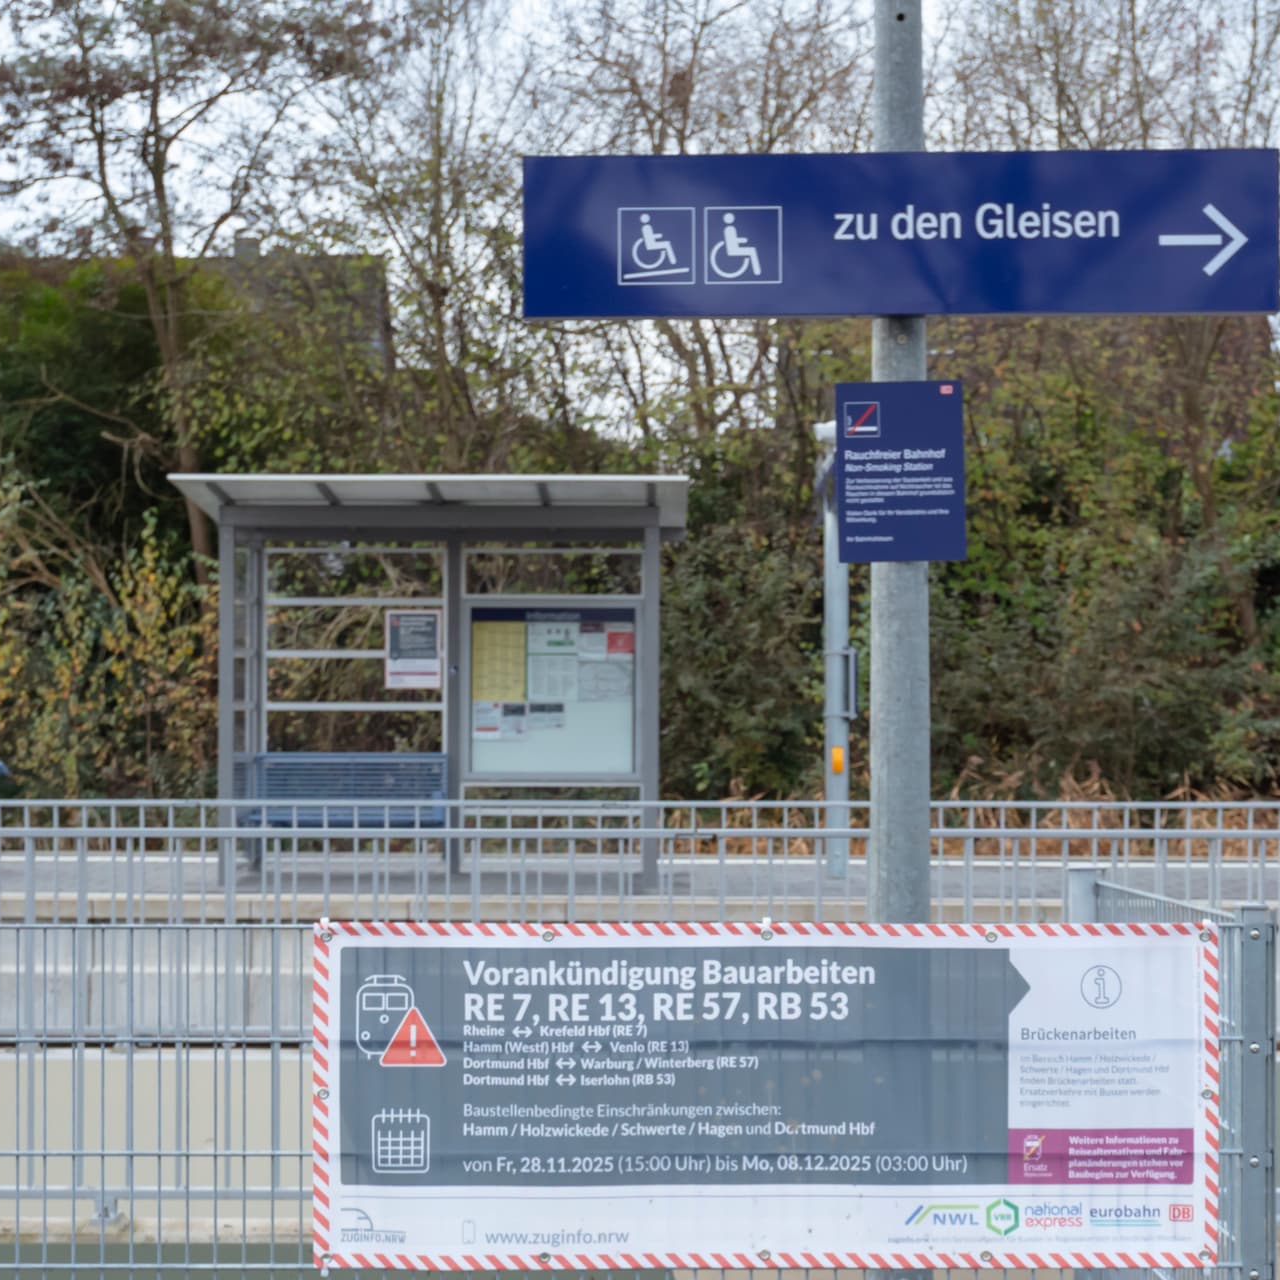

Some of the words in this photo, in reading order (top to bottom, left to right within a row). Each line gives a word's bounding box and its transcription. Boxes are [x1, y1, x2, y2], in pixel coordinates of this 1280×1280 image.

[833, 211, 878, 241] zu
[890, 204, 962, 240] den
[974, 202, 1121, 240] Gleisen
[844, 449, 902, 460] Rauchfreier
[903, 448, 946, 459] Bahnhof
[903, 462, 934, 472] Station
[463, 959, 697, 991] Vorankündigung
[702, 958, 876, 986] Bauarbeiten
[464, 993, 505, 1022] RE
[512, 993, 541, 1026] 7,
[548, 993, 590, 1022] RE
[599, 992, 646, 1026] 13,
[653, 993, 695, 1021] RE
[701, 992, 750, 1024] 57,
[757, 992, 802, 1021] RB
[809, 991, 850, 1021] 53
[463, 1025, 505, 1037] Rheine
[540, 1024, 586, 1037] Krefeld
[588, 1024, 611, 1037] Hbf
[612, 1025, 633, 1038] (RE
[634, 1025, 648, 1038] 7)
[1020, 1027, 1137, 1041] Brückenarbeiten
[463, 1041, 503, 1053] Hamm
[504, 1040, 550, 1055] (Westf)
[551, 1040, 574, 1053] Hbf
[609, 1040, 645, 1053] Venlo
[647, 1041, 668, 1054] (RE
[670, 1041, 689, 1054] 13)
[463, 1057, 525, 1070] Dortmund
[527, 1057, 550, 1070] Hbf
[580, 1057, 635, 1072] Warburg
[644, 1056, 714, 1070] Winterberg
[716, 1057, 738, 1070] (RE
[739, 1056, 759, 1070] 57)
[463, 1073, 525, 1086] Dortmund
[527, 1073, 550, 1086] Hbf
[580, 1073, 630, 1086] Iserlohn
[632, 1073, 654, 1087] (RB
[655, 1073, 676, 1087] 53)
[463, 1103, 594, 1120] Baustellenbedingte
[597, 1103, 713, 1119] Einschränkungen
[715, 1103, 782, 1116] zwischen:
[463, 1124, 508, 1136] Hamm
[520, 1123, 610, 1137] Holzwickede
[620, 1123, 686, 1136] Schwerte
[698, 1123, 743, 1138] Hagen
[745, 1122, 771, 1135] und
[774, 1122, 846, 1135] Dortmund
[849, 1122, 876, 1135] Hbf
[1068, 1135, 1105, 1145] Weitere
[1105, 1135, 1167, 1145] Informationen
[1168, 1136, 1179, 1145] zu
[1068, 1147, 1145, 1156] Reisealternativen
[1146, 1147, 1162, 1156] und
[463, 1159, 493, 1173] von
[496, 1156, 517, 1174] Fr,
[520, 1156, 614, 1173] 28.11.2025
[618, 1155, 672, 1174] (15:00
[674, 1155, 711, 1174] Uhr)
[714, 1155, 738, 1171] bis
[741, 1156, 774, 1173] Mo,
[776, 1154, 871, 1171] 08.12.2025
[875, 1154, 929, 1173] (03:00
[931, 1154, 969, 1172] Uhr)
[1023, 1163, 1048, 1172] Ersatz
[1139, 1159, 1168, 1168] stehen
[1169, 1159, 1184, 1168] vor
[1068, 1170, 1114, 1180] Baubeginn
[1115, 1171, 1129, 1179] zur
[1024, 1202, 1082, 1217] national
[1089, 1204, 1161, 1218] eurobahn
[1172, 1207, 1192, 1219] DB
[932, 1213, 980, 1226] NWL
[1024, 1215, 1083, 1230] express
[340, 1231, 407, 1244] ZUGINFO.NRW
[484, 1230, 630, 1248] www.zuginfo.nrw
